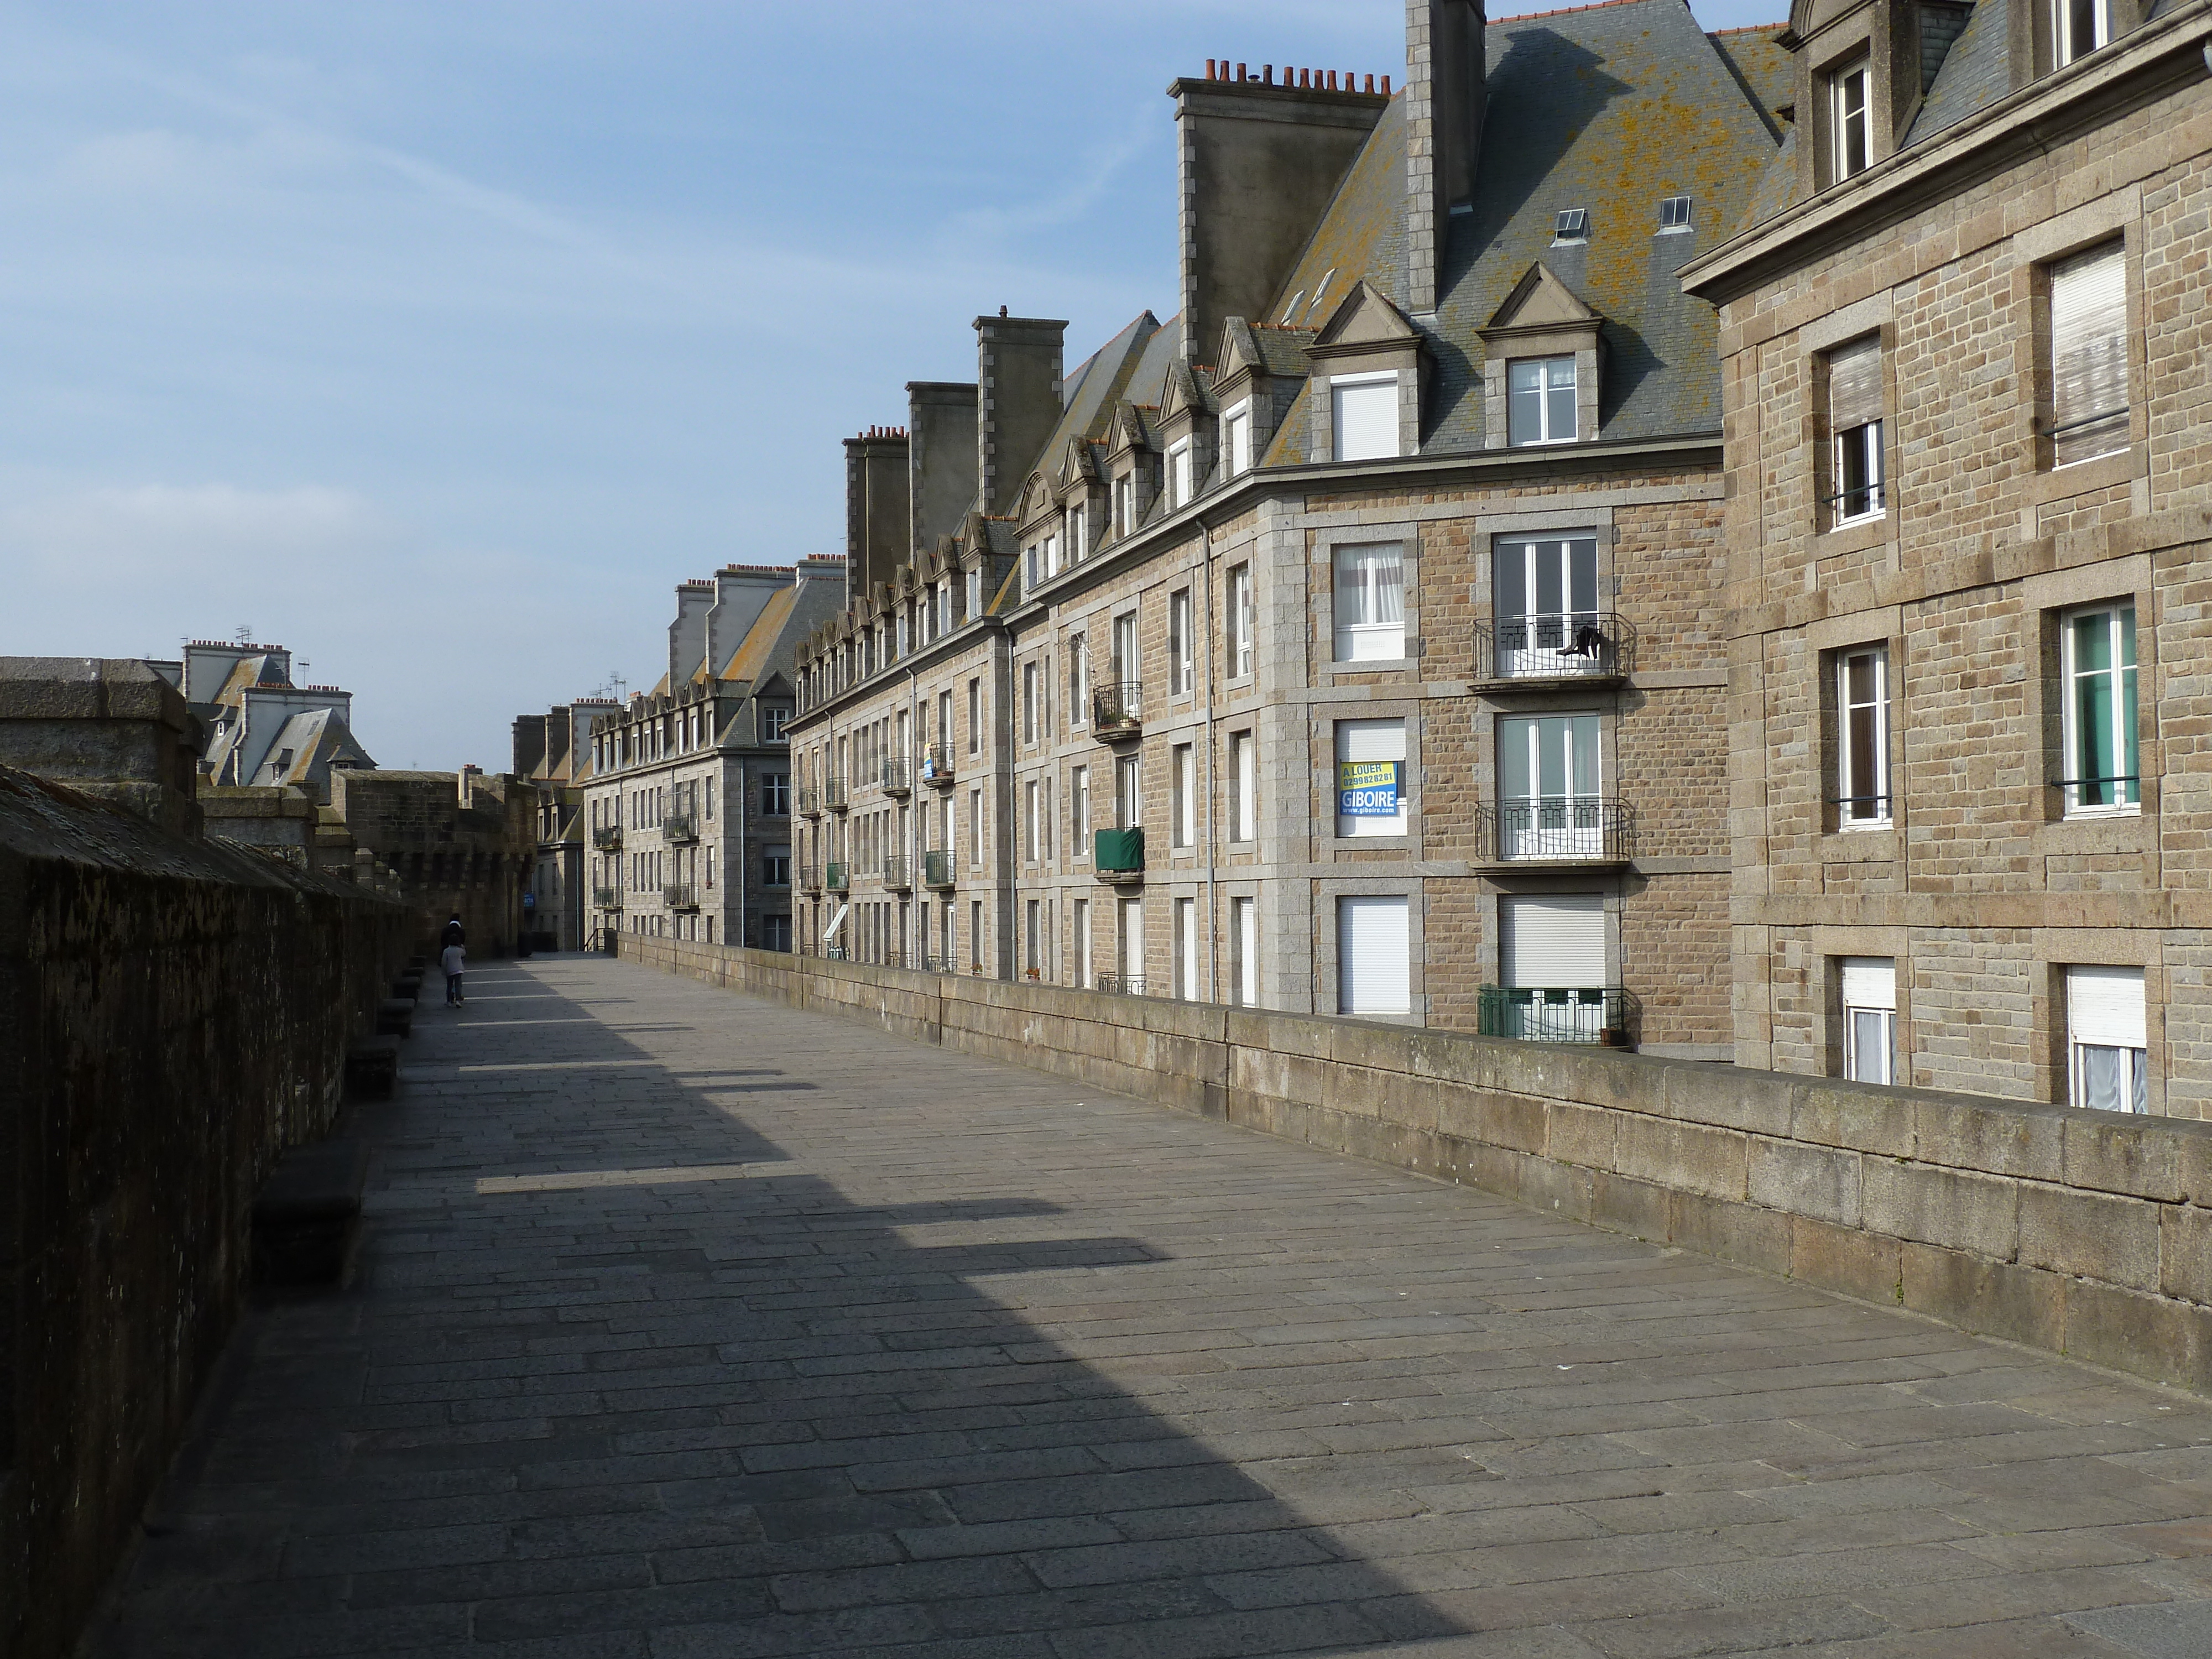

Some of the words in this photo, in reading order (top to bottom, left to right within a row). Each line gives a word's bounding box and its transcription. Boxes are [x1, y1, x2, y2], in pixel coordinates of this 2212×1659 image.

[1344, 768, 1350, 776] A
[1352, 763, 1381, 775] LOUER
[1343, 791, 1395, 807] GIBOIRE
